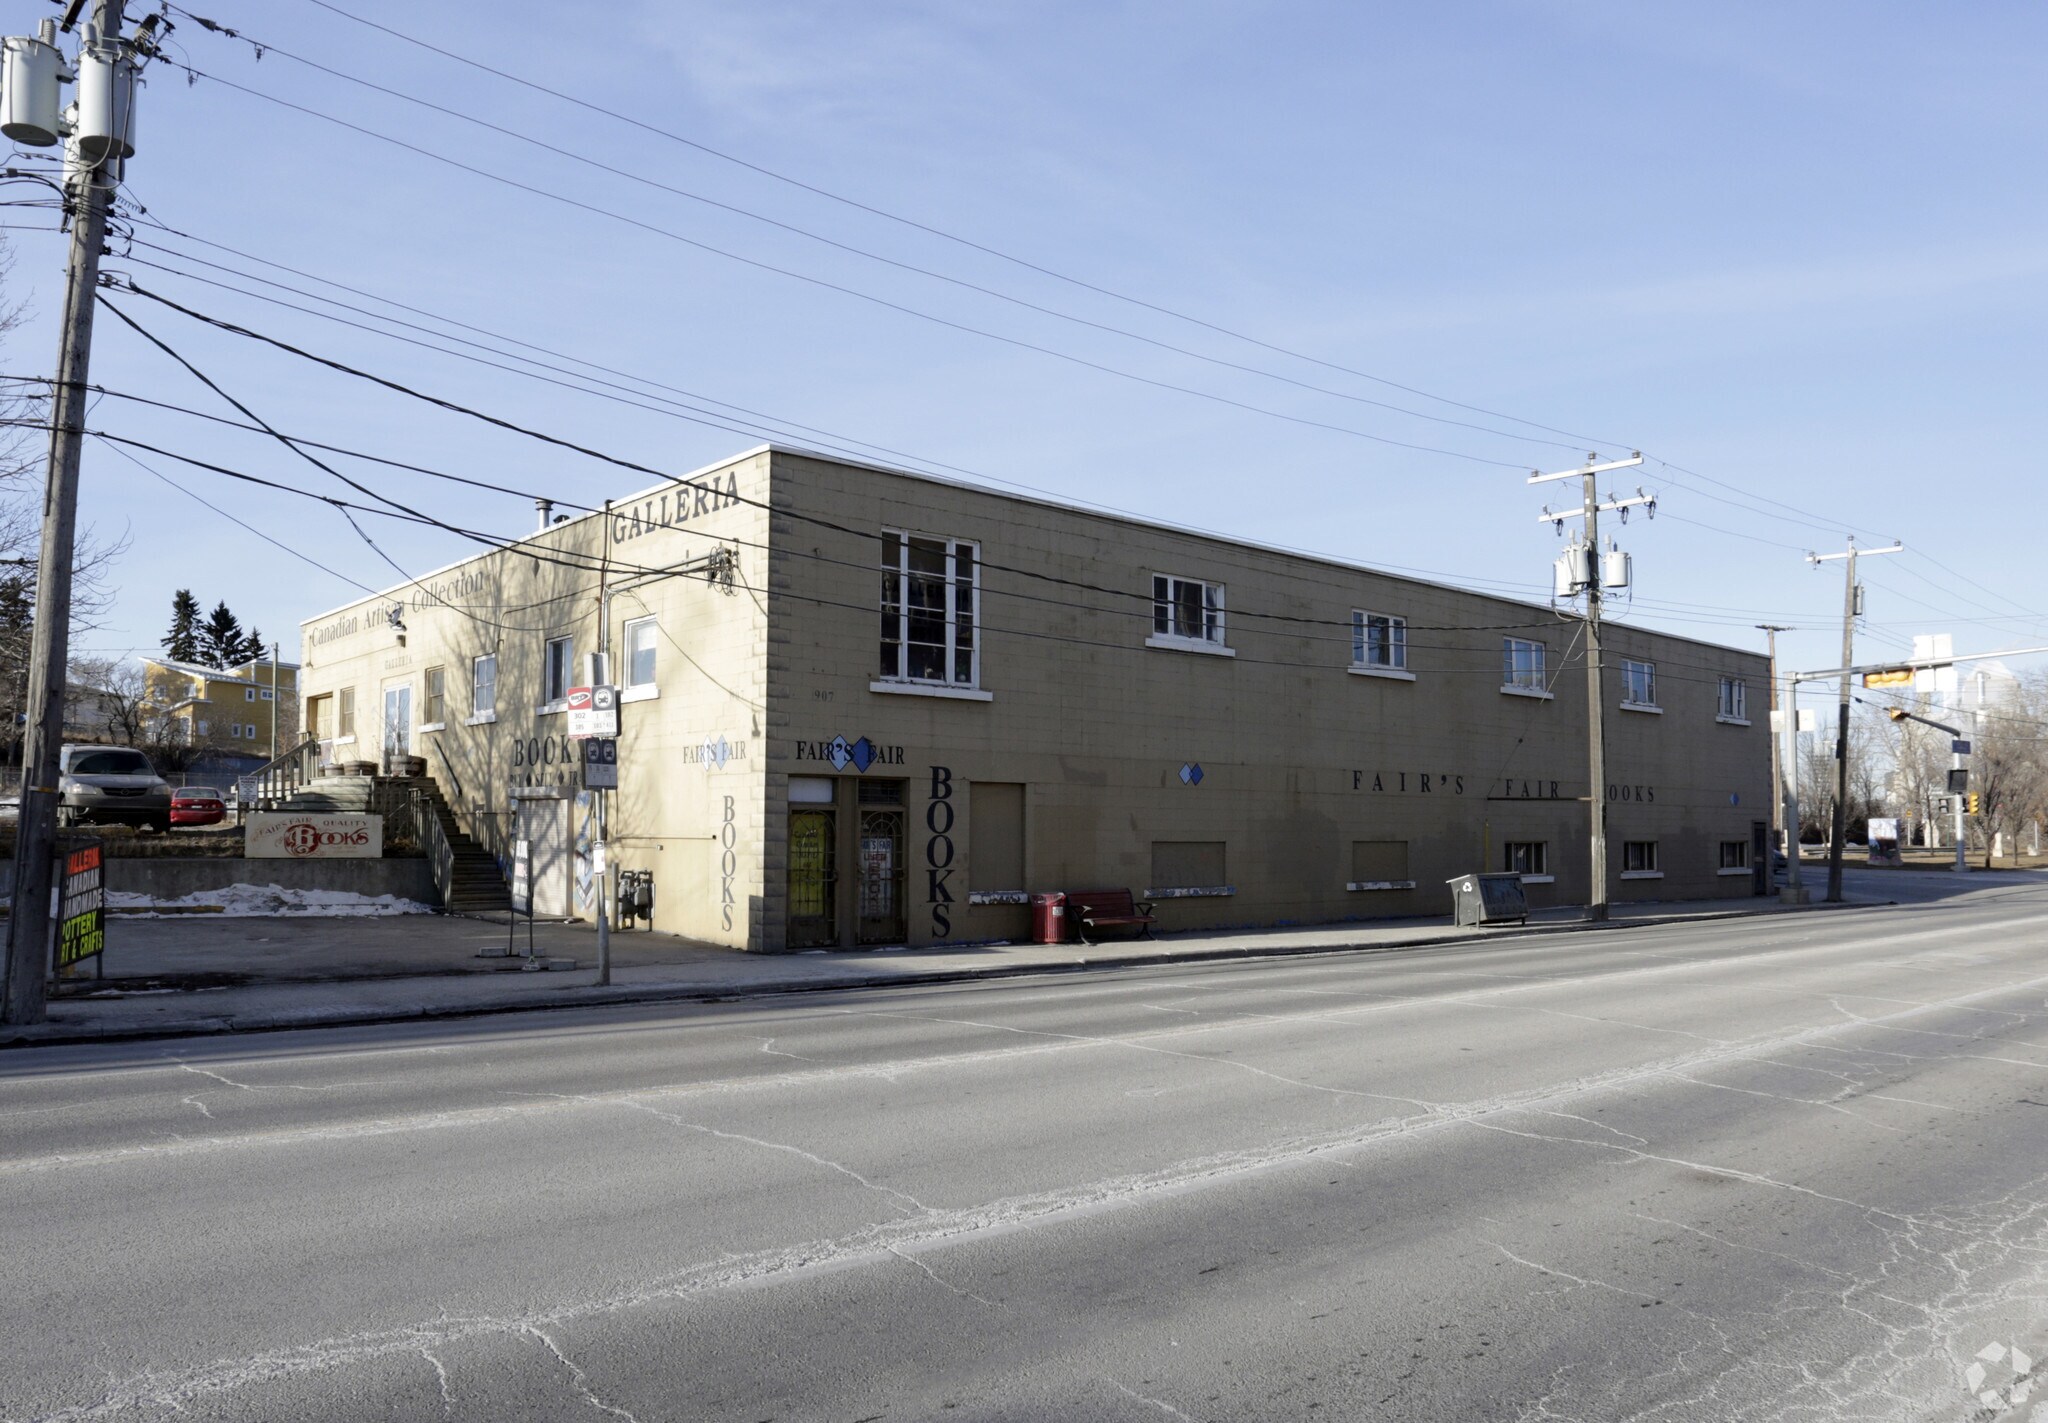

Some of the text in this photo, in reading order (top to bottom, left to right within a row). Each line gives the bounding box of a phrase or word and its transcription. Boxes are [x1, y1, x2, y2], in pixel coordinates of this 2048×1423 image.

[613, 471, 740, 544] GALLERIA
[311, 615, 357, 647] Canadian
[412, 570, 483, 613] Collection
[384, 654, 413, 670] GALLERIA
[814, 690, 834, 701] 907
[683, 741, 746, 764] FAIR'S FAIR
[796, 740, 905, 765] FAIR'S FAIR
[1352, 770, 1655, 802] FAIR'S FAIR OOKS
[289, 816, 312, 826] FAIR
[67, 847, 100, 876] ALLERIA
[721, 795, 736, 932] BOOKS
[926, 765, 956, 938] BOOKS
[61, 941, 70, 965] RT
[80, 929, 103, 957] CRAFTS
